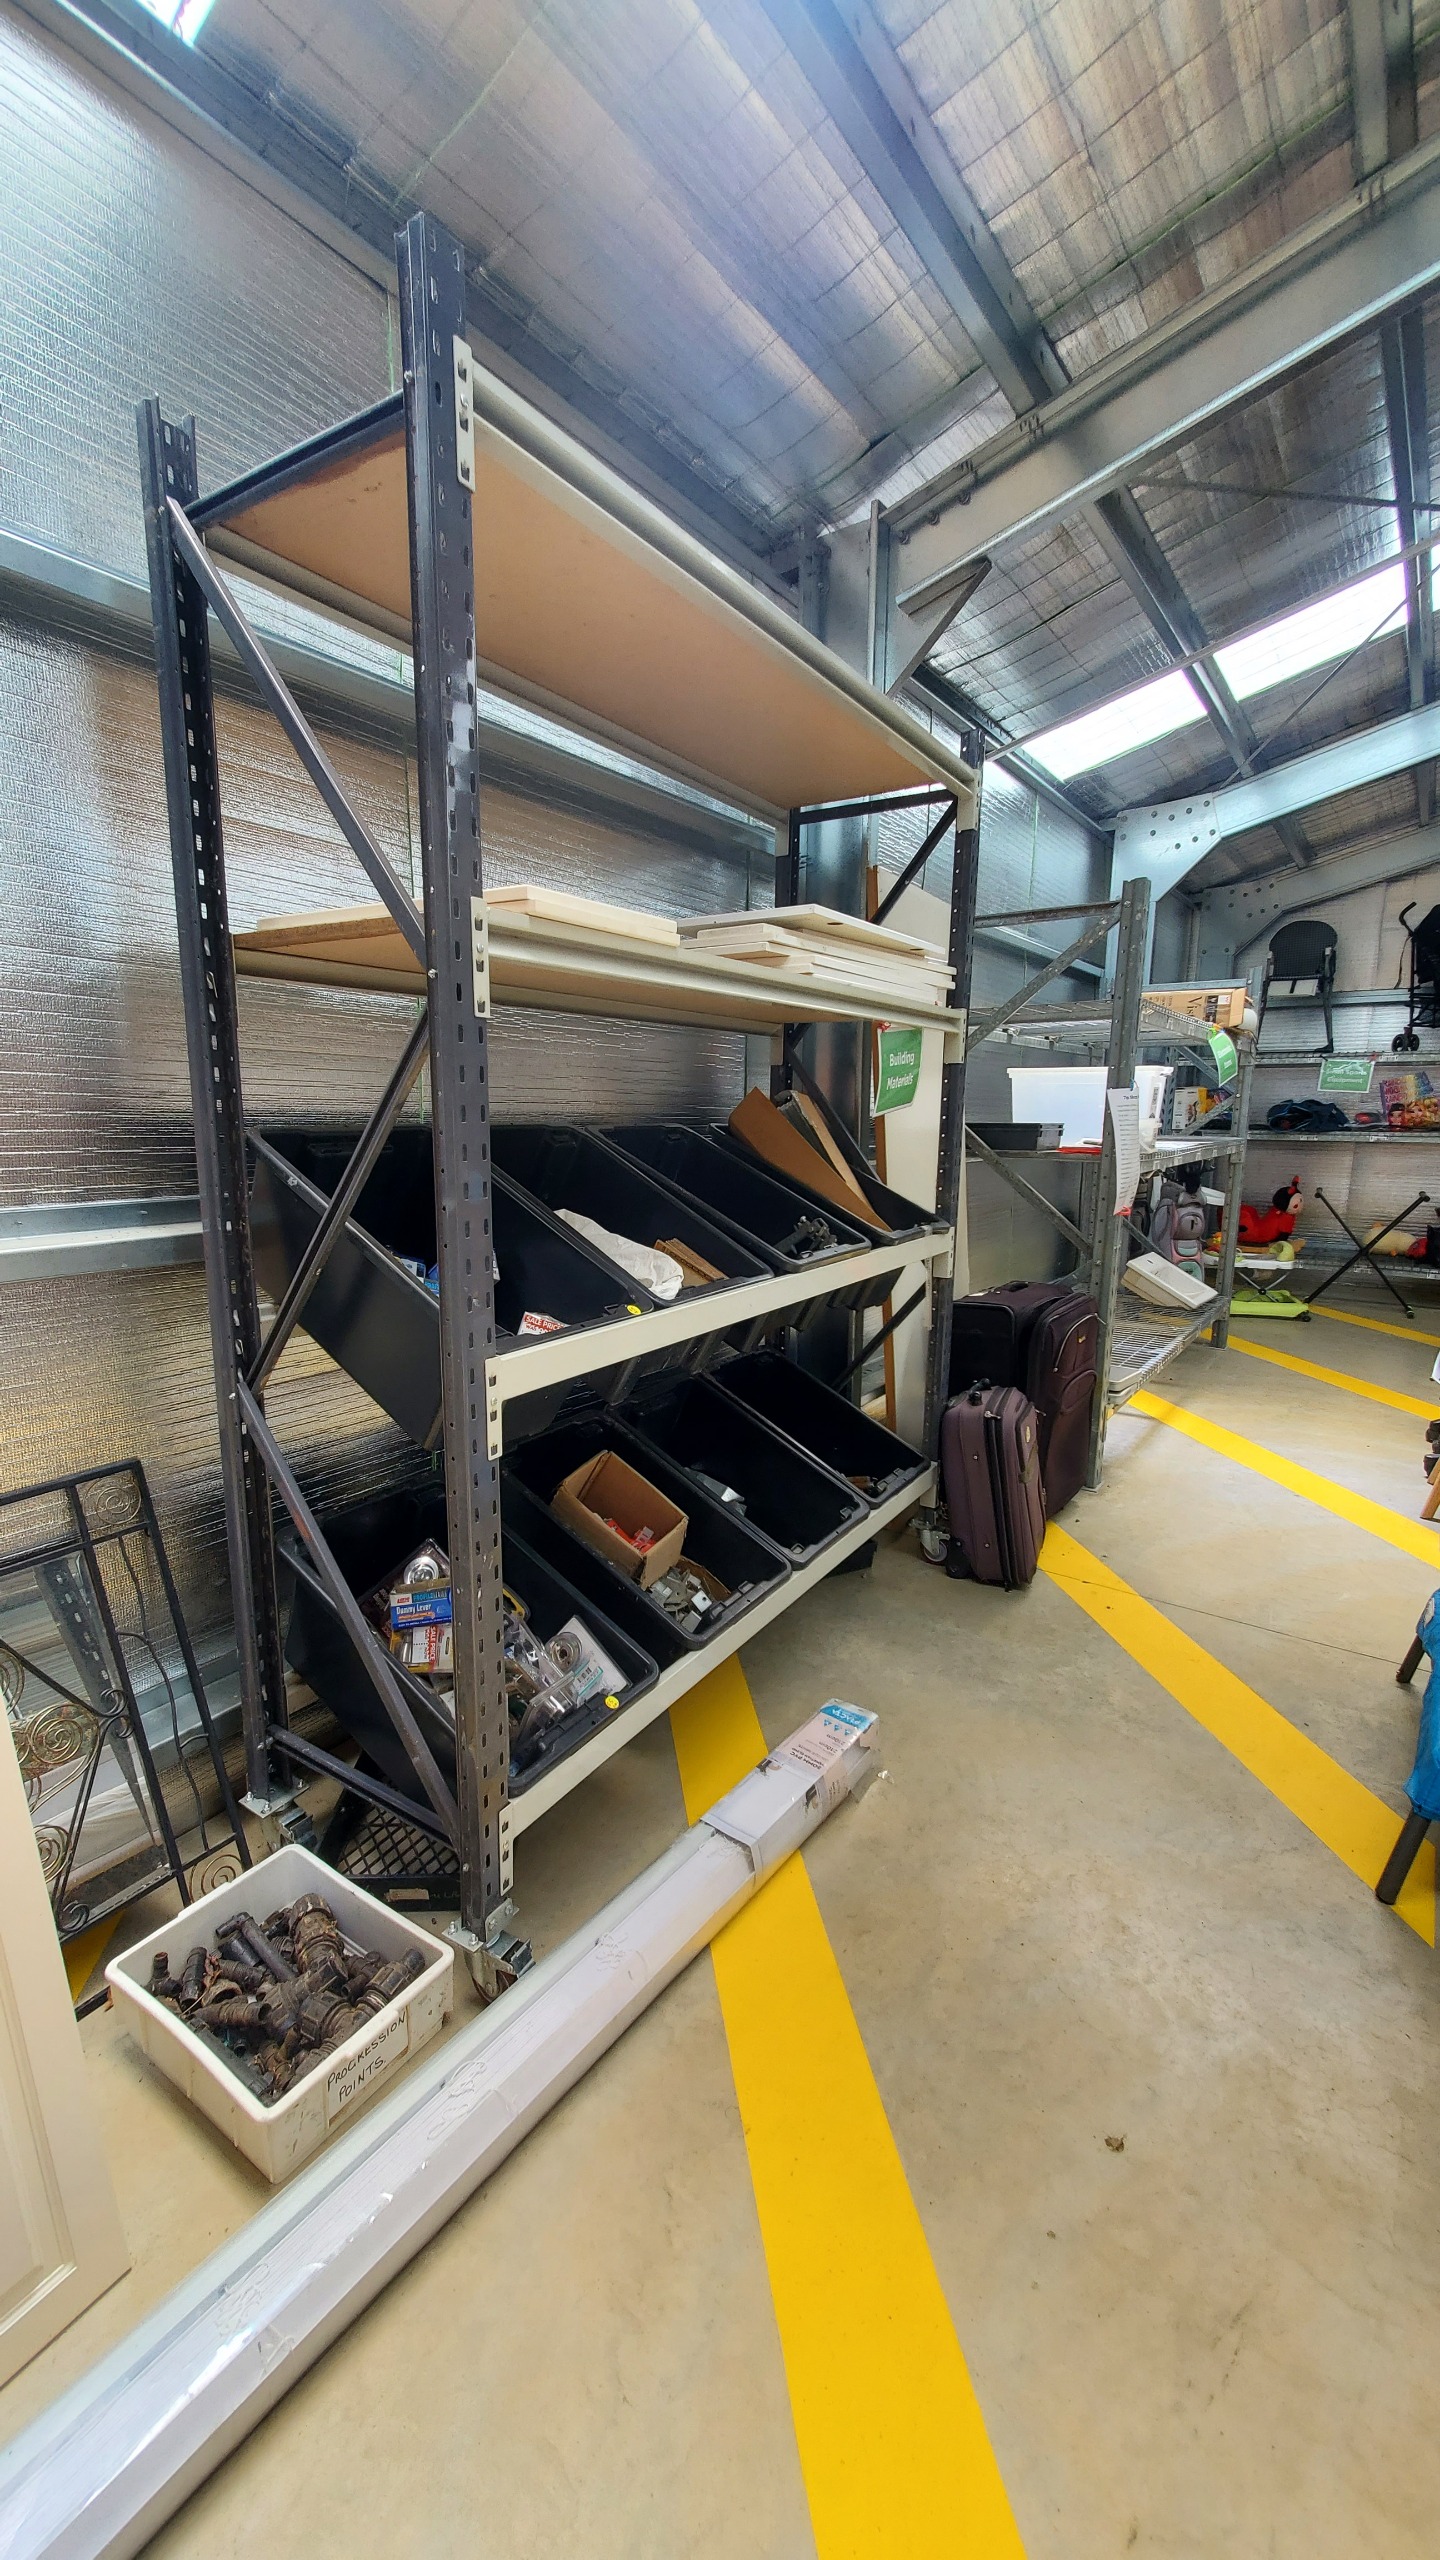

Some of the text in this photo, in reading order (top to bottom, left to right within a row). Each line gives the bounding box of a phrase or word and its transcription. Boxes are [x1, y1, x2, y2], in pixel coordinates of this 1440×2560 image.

[889, 1051, 915, 1067] Building
[886, 1074, 914, 1091] Materials
[525, 1315, 542, 1325] SALE
[416, 1603, 432, 1612] Lever
[429, 1643, 437, 1661] PRICE
[789, 1751, 804, 1760] PVC
